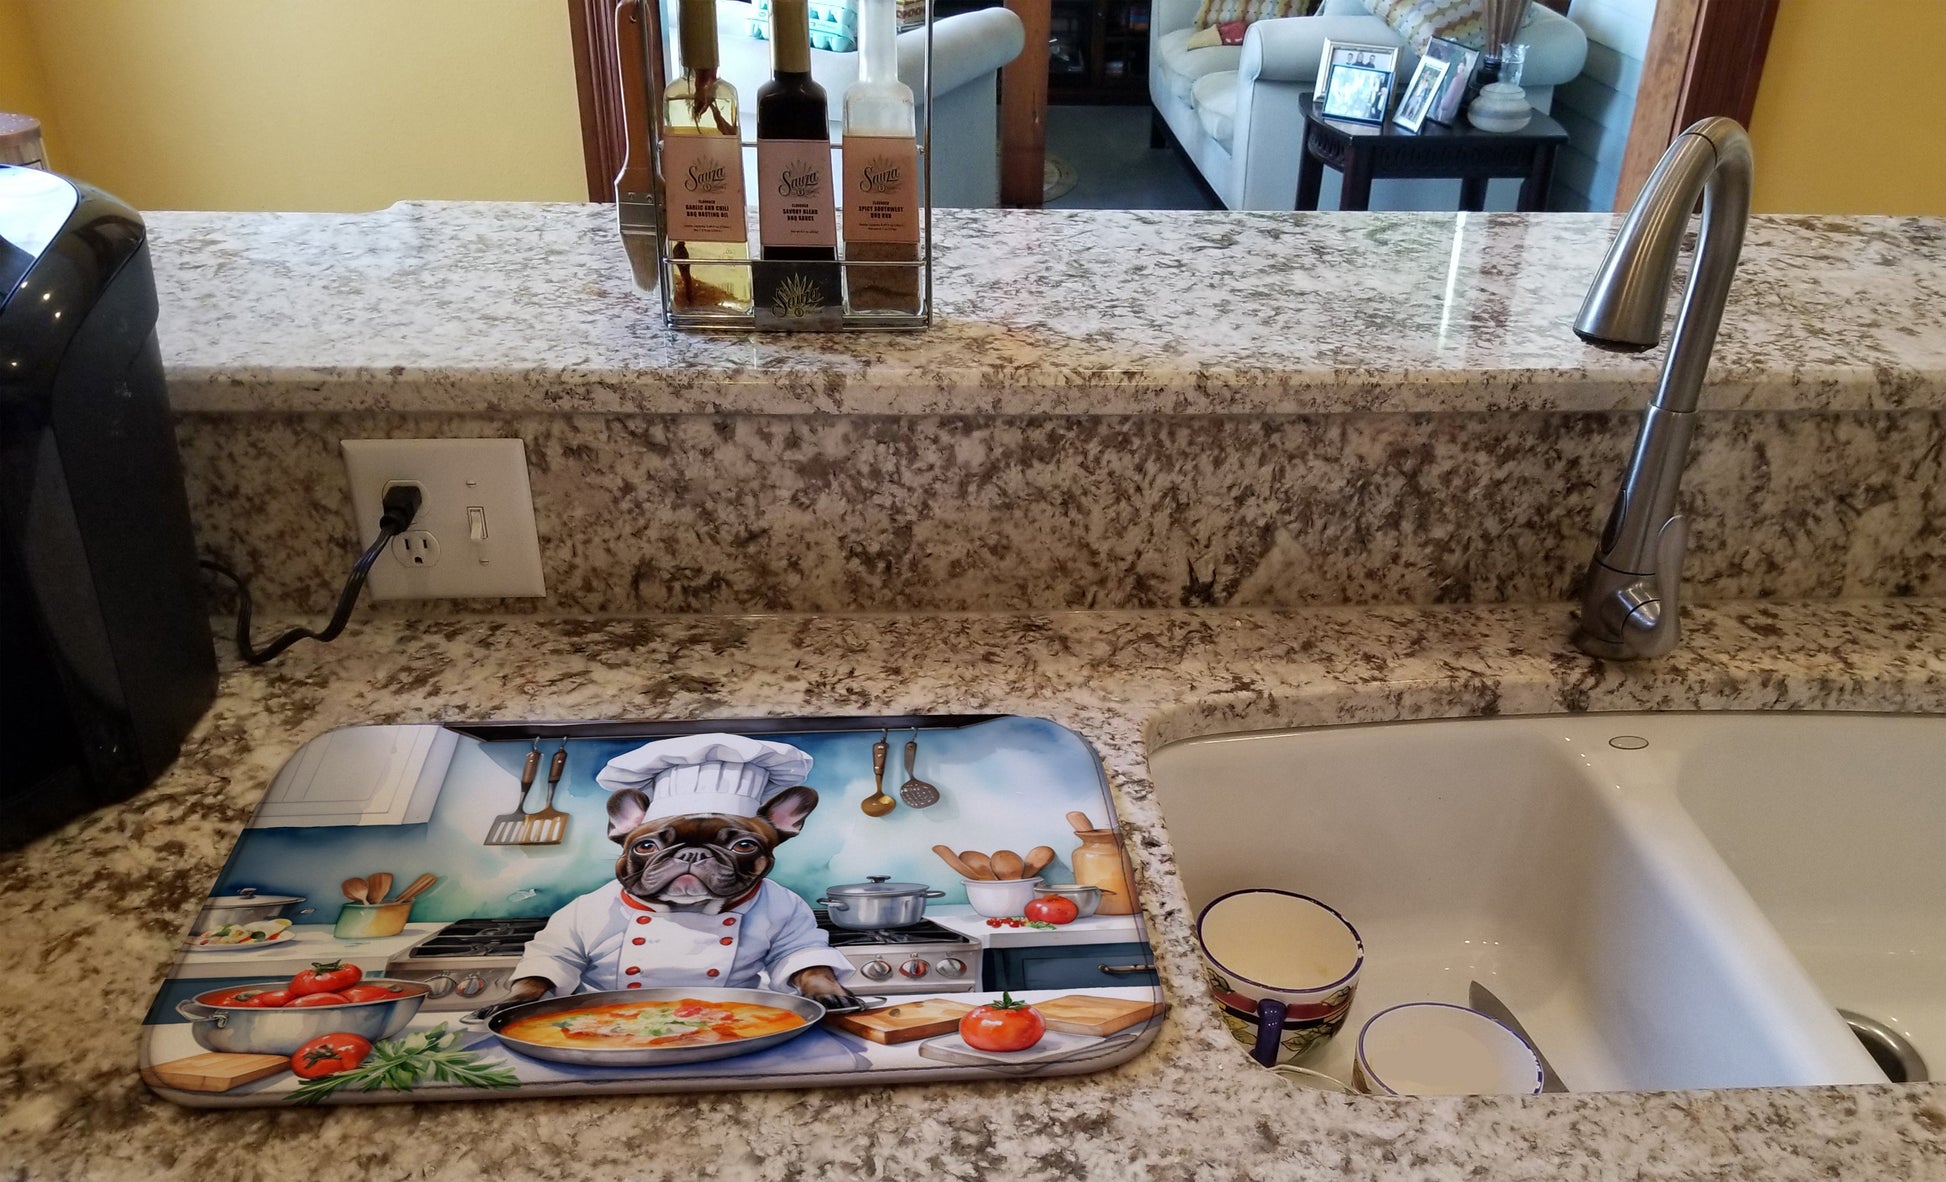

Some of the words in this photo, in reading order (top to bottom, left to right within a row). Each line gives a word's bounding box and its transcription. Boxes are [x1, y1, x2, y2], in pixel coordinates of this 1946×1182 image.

[685, 165, 725, 192] Sauza
[778, 170, 818, 197] Sauza
[860, 166, 900, 192] Sauza
